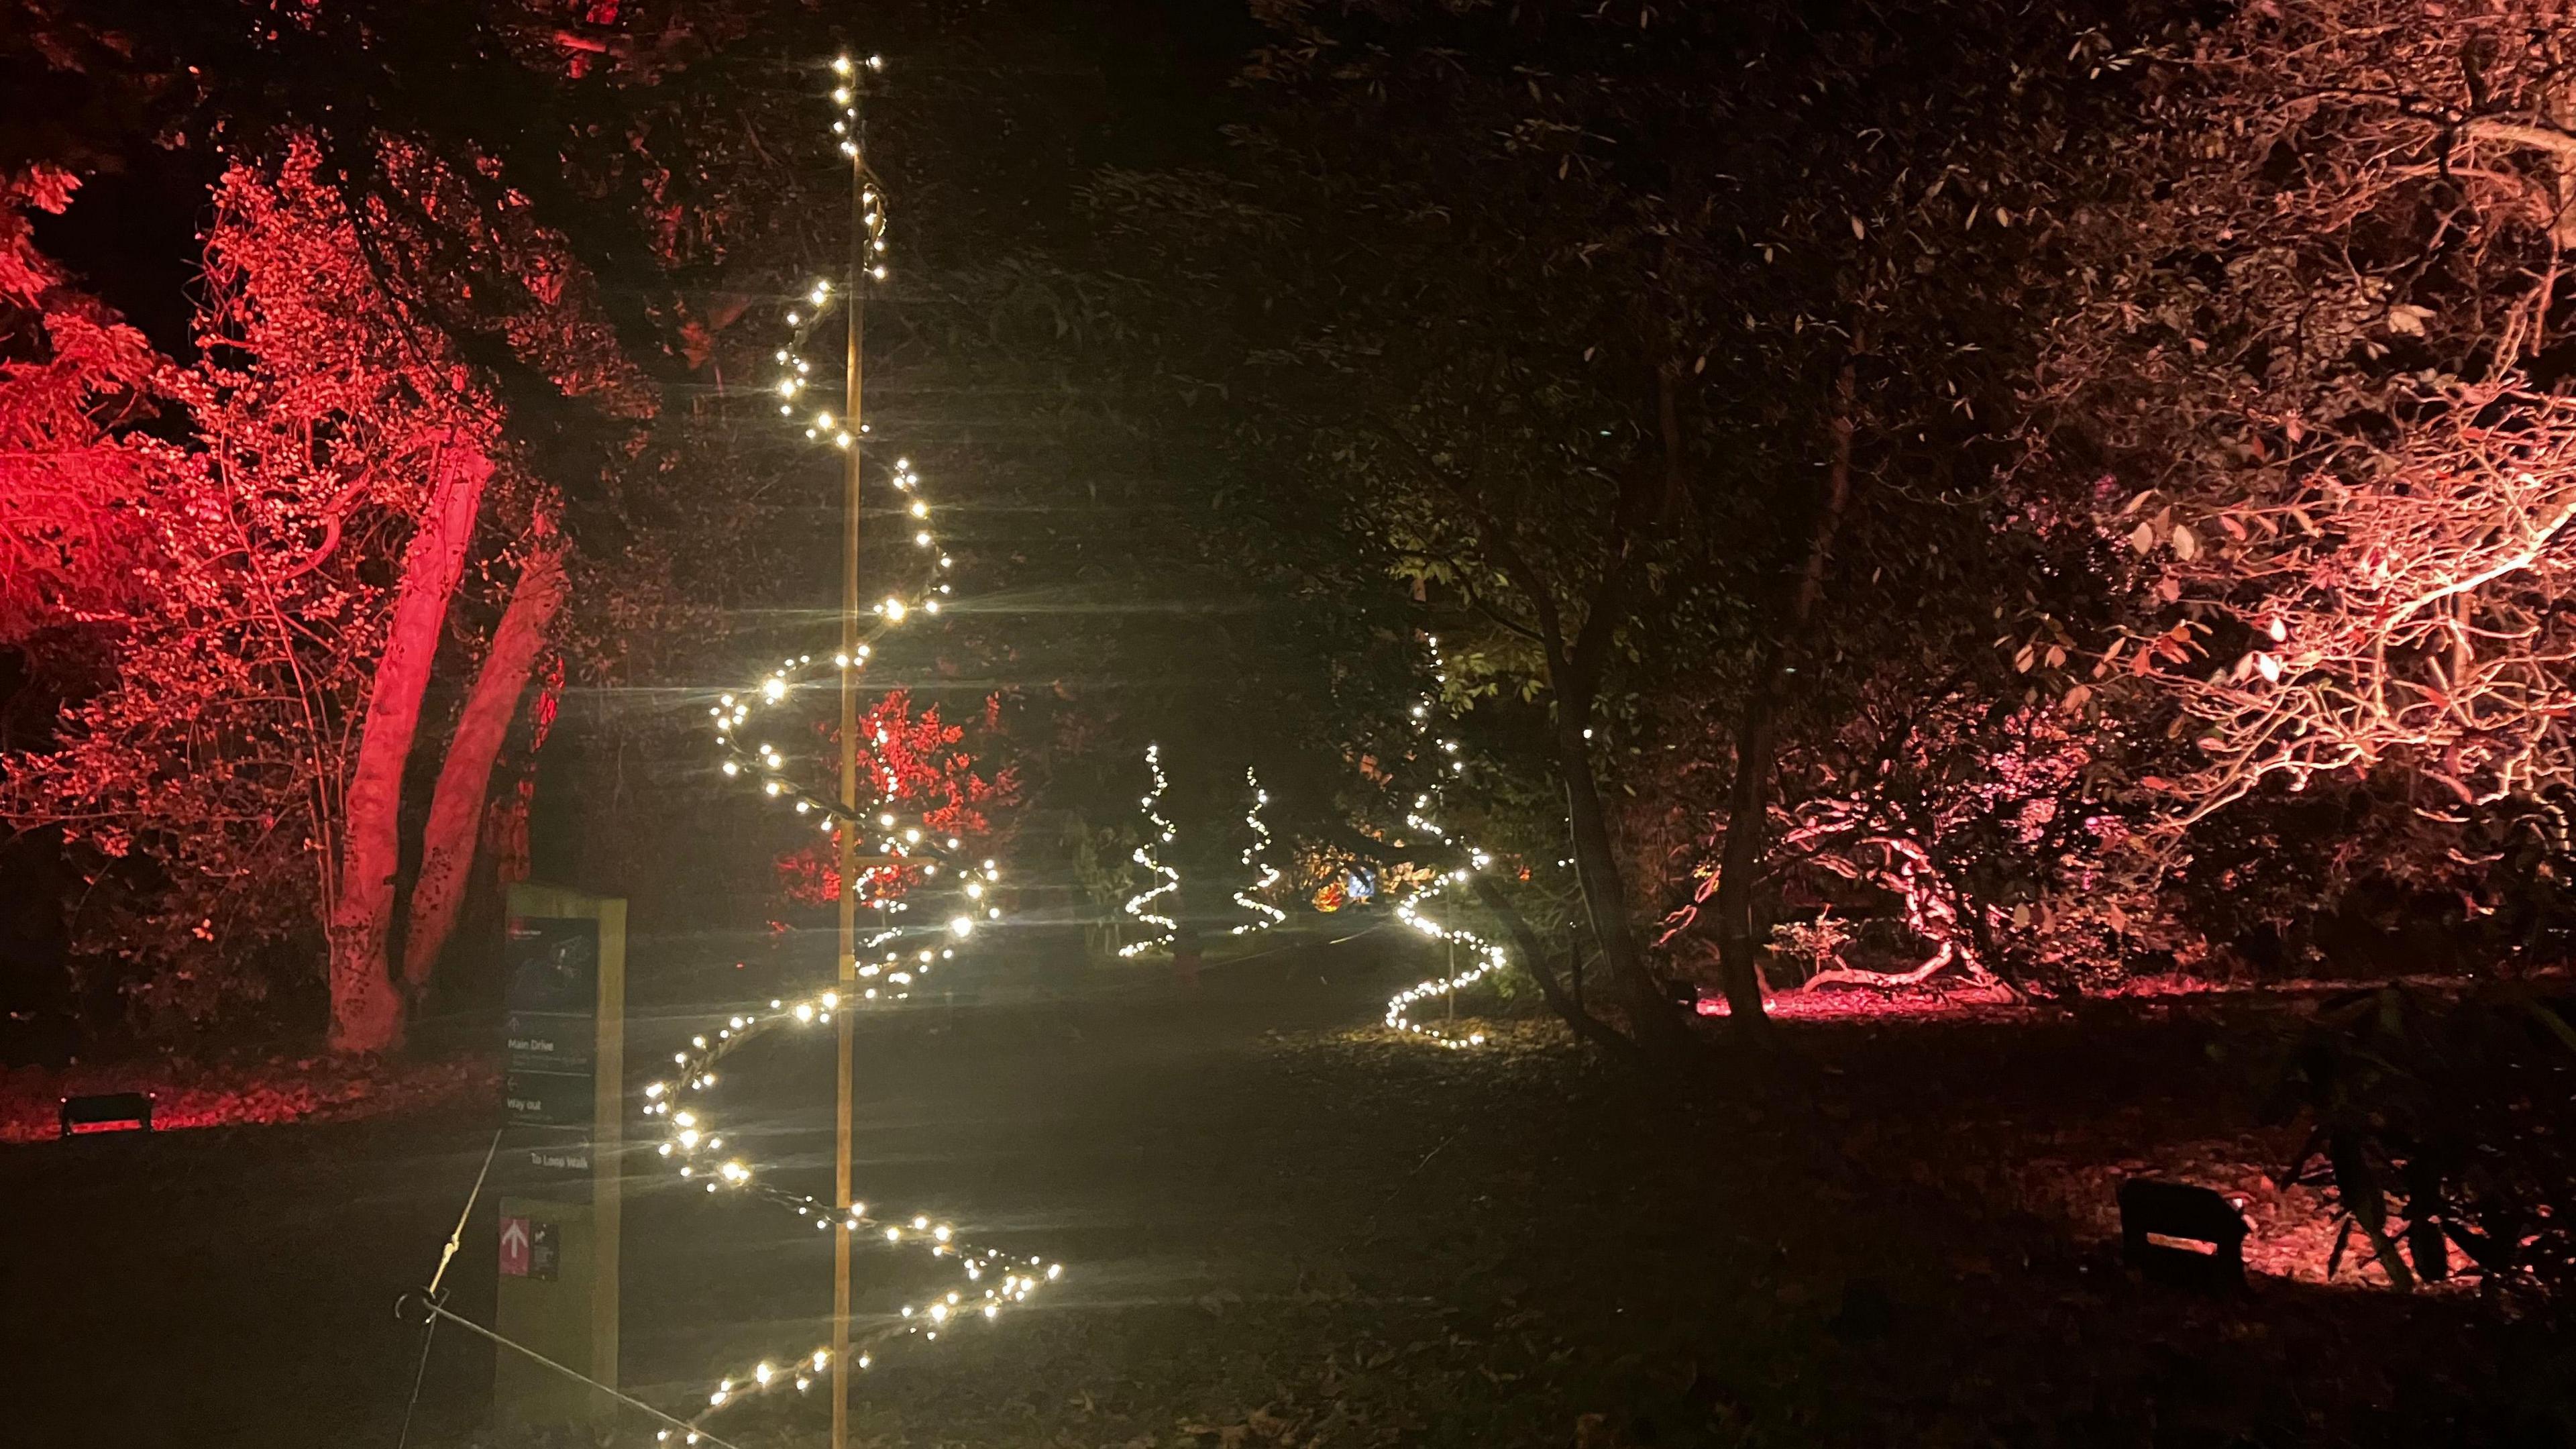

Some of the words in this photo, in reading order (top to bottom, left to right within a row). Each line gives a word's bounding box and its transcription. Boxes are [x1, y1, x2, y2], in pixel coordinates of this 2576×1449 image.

[508, 1038, 529, 1050] Main
[531, 1039, 553, 1051] Drive
[507, 1097, 524, 1111] Way
[527, 1100, 541, 1110] out
[531, 1152, 542, 1165] To
[566, 1156, 588, 1169] Walk
